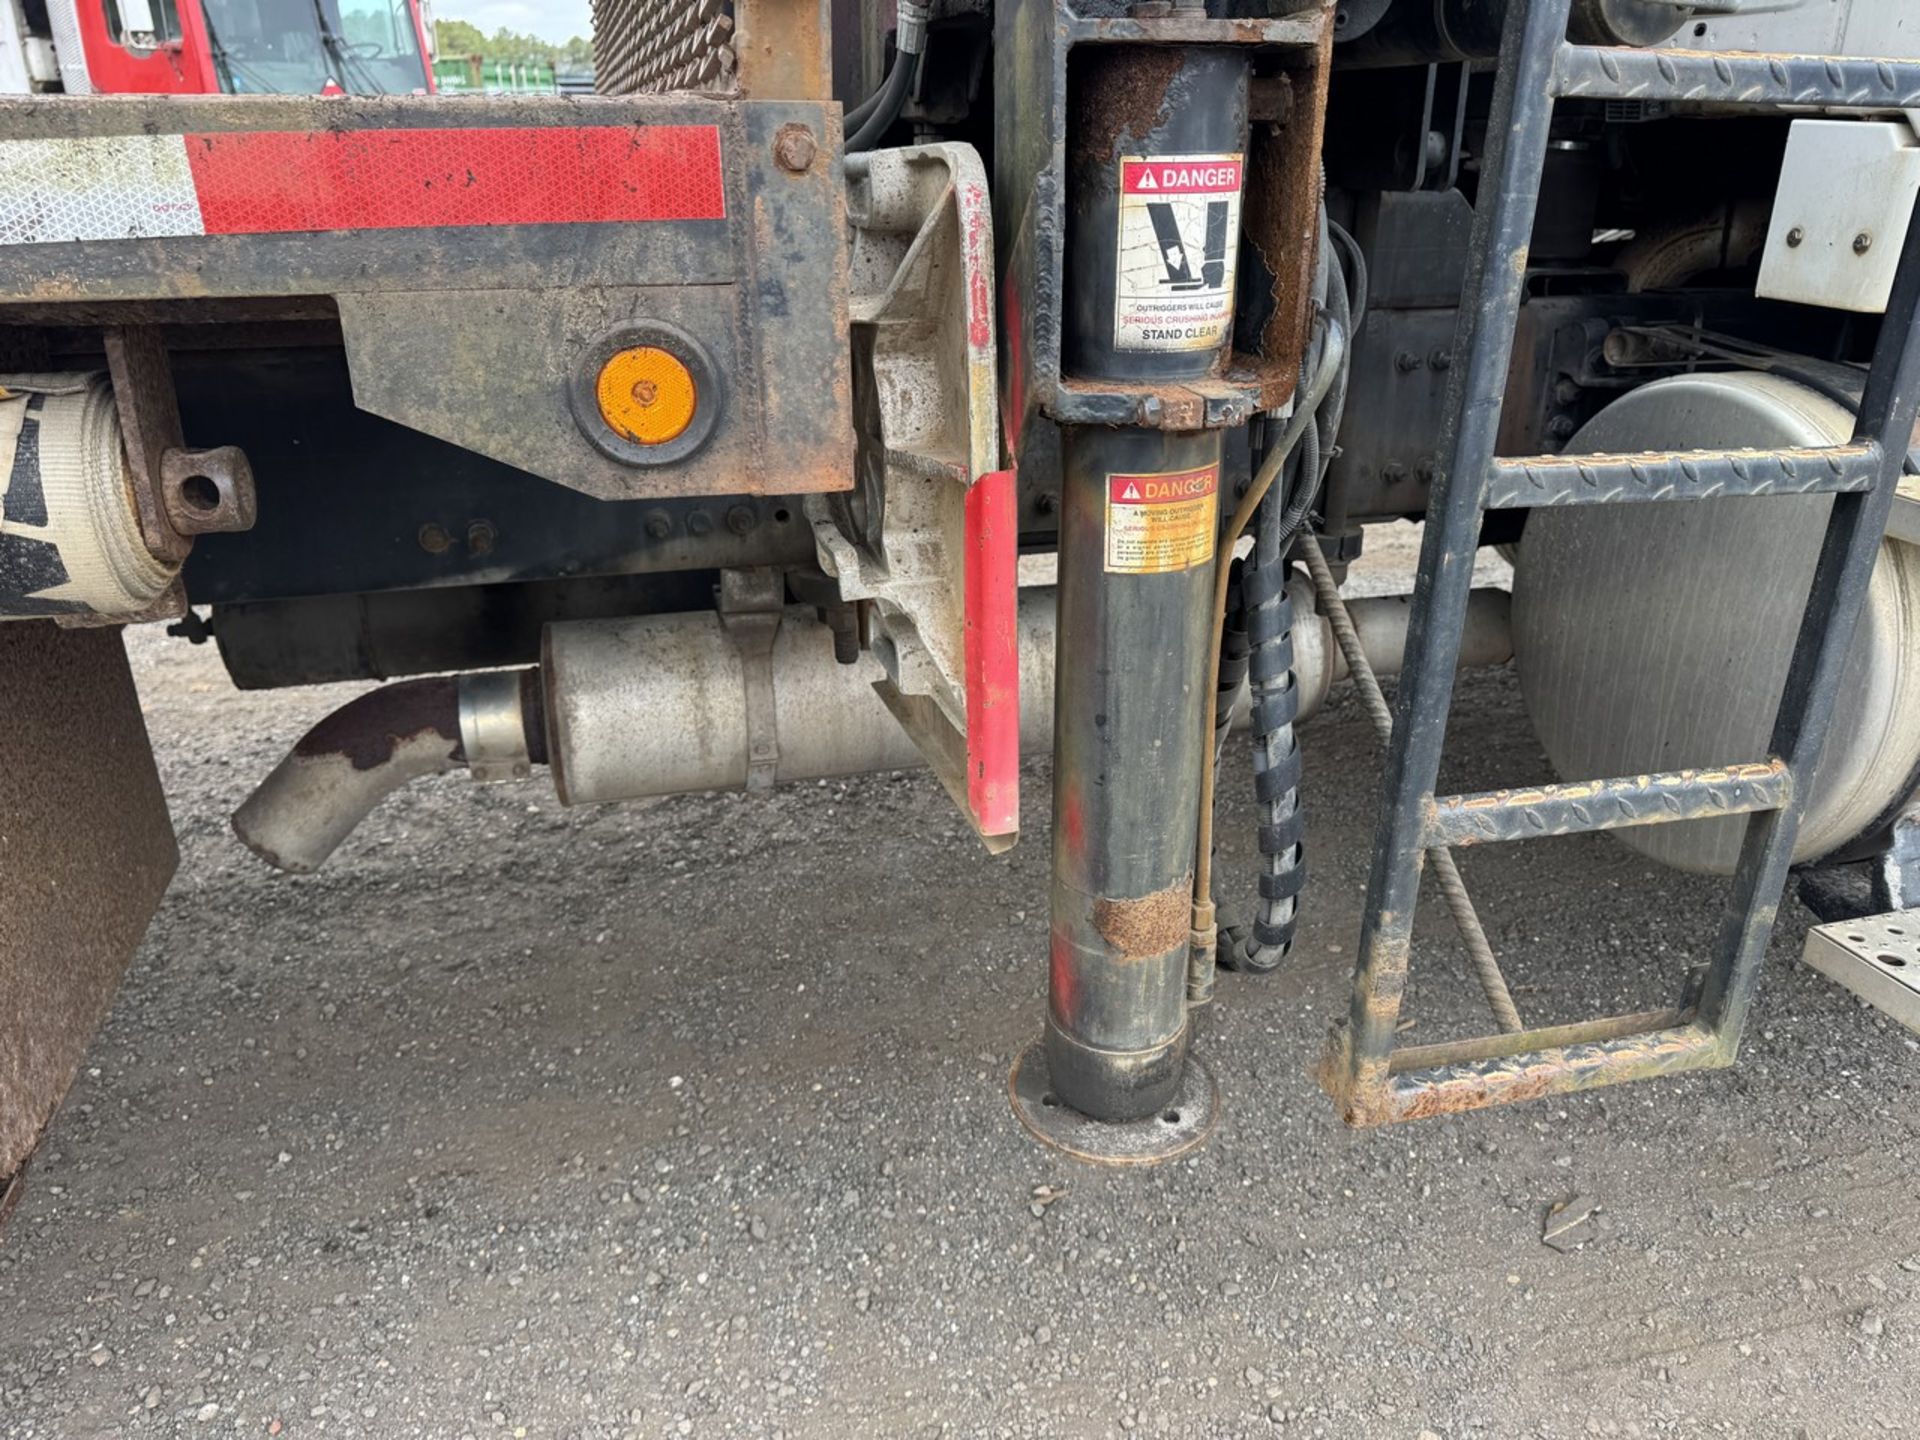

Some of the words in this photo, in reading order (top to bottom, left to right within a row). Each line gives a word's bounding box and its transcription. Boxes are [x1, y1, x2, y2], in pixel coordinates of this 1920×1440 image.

[1162, 167, 1236, 188] DANGER
[1136, 303, 1187, 312] OUTRIGGERS
[1188, 303, 1204, 311] WILL
[1122, 315, 1164, 325] SERIOUS
[1165, 313, 1209, 325] CRUSHING
[1142, 329, 1183, 340] STAND
[1184, 325, 1218, 339] CLEAR
